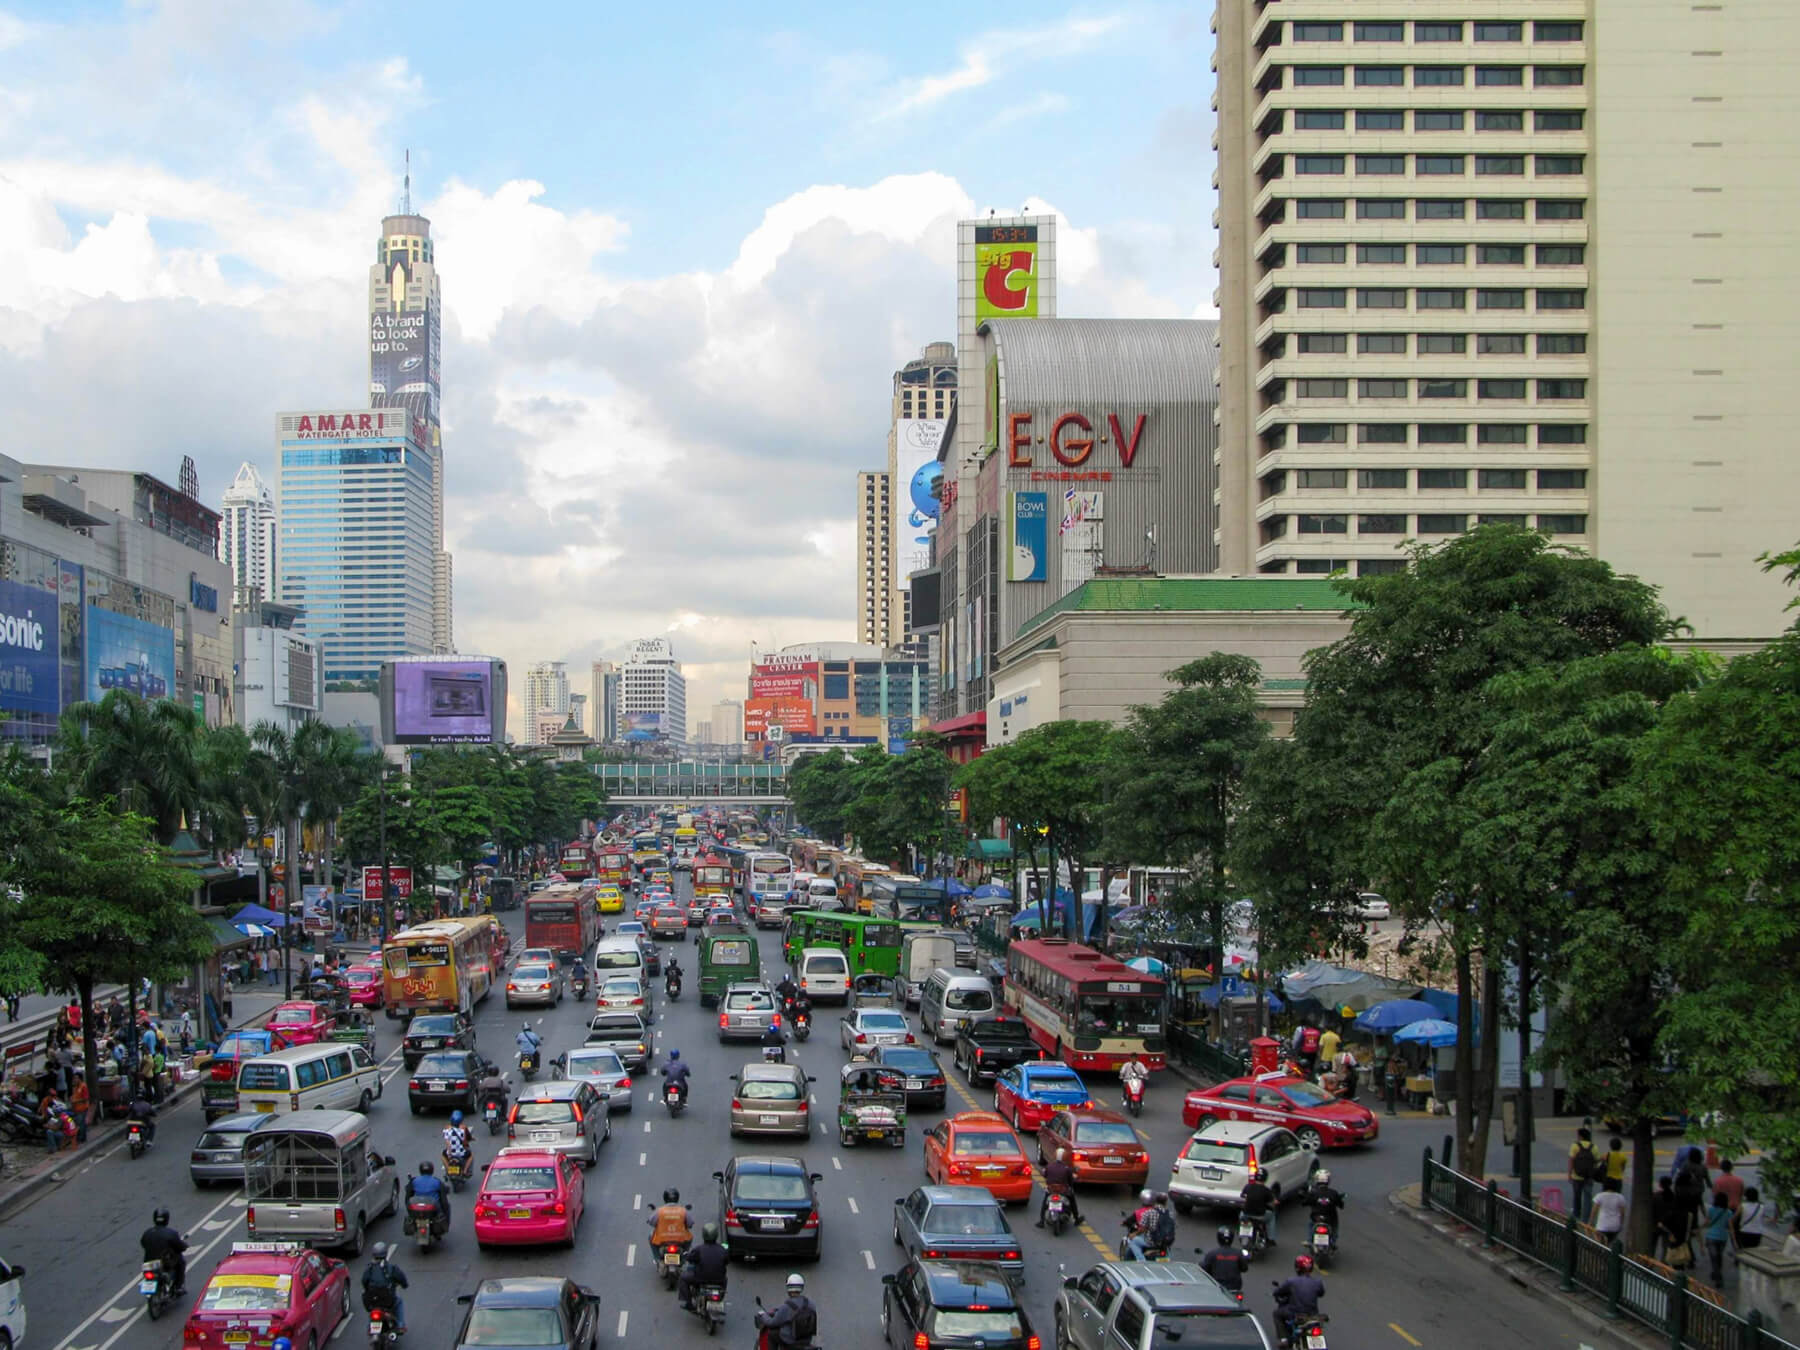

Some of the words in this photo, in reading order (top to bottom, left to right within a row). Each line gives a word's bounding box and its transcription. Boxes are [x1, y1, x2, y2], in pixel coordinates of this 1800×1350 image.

[980, 251, 1013, 270] Big
[982, 250, 1034, 311] C
[372, 315, 384, 328] A
[386, 313, 425, 328] brand
[372, 327, 386, 340] to
[388, 326, 418, 340] look
[371, 341, 390, 354] up
[391, 340, 409, 352] to.
[298, 413, 385, 432] AMARI
[297, 430, 351, 440] WATERGATE
[355, 429, 385, 438] HOTEL
[1017, 502, 1045, 512] BOWL
[763, 654, 812, 665] PRATUNAM
[769, 662, 804, 673] CENTER
